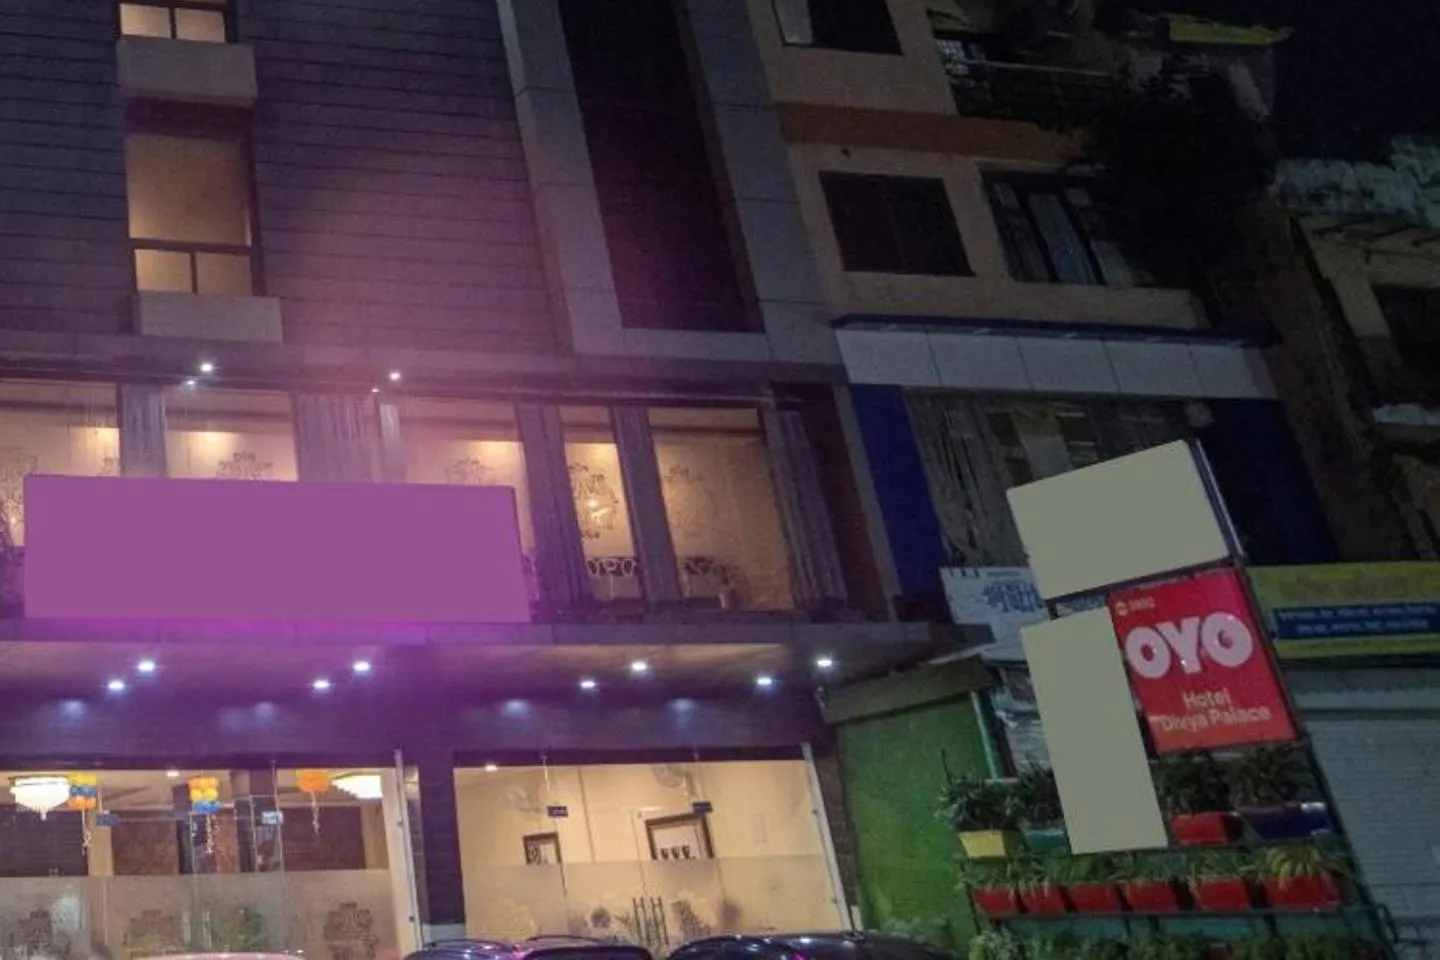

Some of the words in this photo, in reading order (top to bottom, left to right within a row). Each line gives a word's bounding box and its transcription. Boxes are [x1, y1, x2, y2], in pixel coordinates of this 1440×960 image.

[1126, 612, 1253, 678] OYO
[1182, 687, 1231, 709] Hotel
[1161, 714, 1208, 732] Divya
[1210, 705, 1272, 725] Palace
